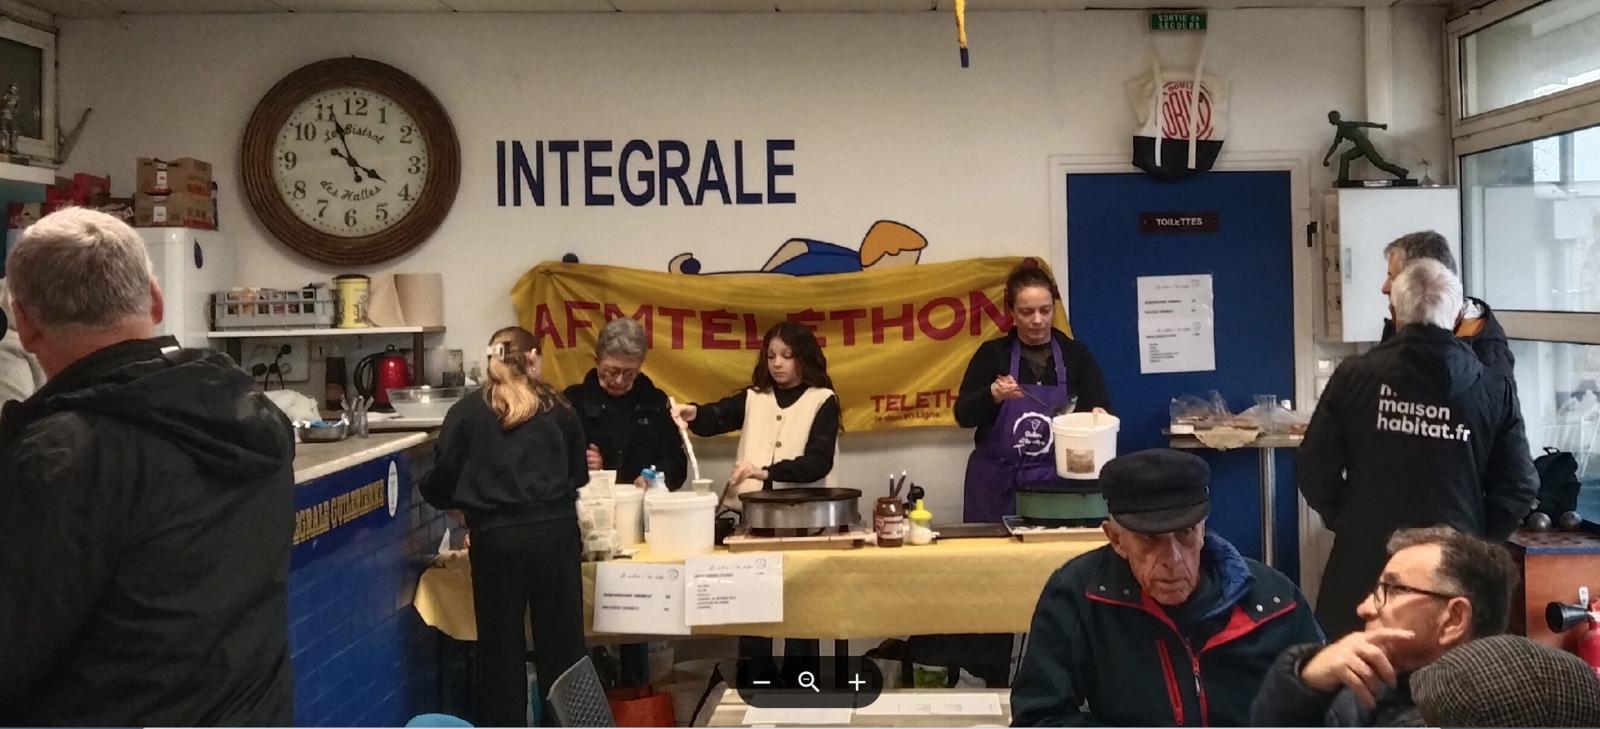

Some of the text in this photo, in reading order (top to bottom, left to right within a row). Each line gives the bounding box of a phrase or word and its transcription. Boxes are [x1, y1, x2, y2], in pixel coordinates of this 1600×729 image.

[1158, 14, 1187, 22] SORTIE
[1158, 22, 1200, 30] SECOURS
[315, 103, 336, 122] 11
[343, 97, 369, 116] 12
[378, 106, 388, 124] 1
[294, 122, 317, 142] 10
[344, 123, 385, 145] Bistrot
[399, 125, 413, 144] 2
[284, 151, 297, 170] 9
[407, 155, 421, 175] 3
[496, 139, 797, 207] INTEGRALE
[292, 180, 307, 200] 8
[320, 180, 382, 202] des Halles
[398, 183, 411, 201] 4
[317, 199, 329, 218] 7
[344, 208, 358, 228] 6
[375, 202, 389, 221] 5
[1155, 216, 1204, 227] TOILETTES
[1378, 398, 1451, 421] maison
[1376, 411, 1471, 442] habitat.fr
